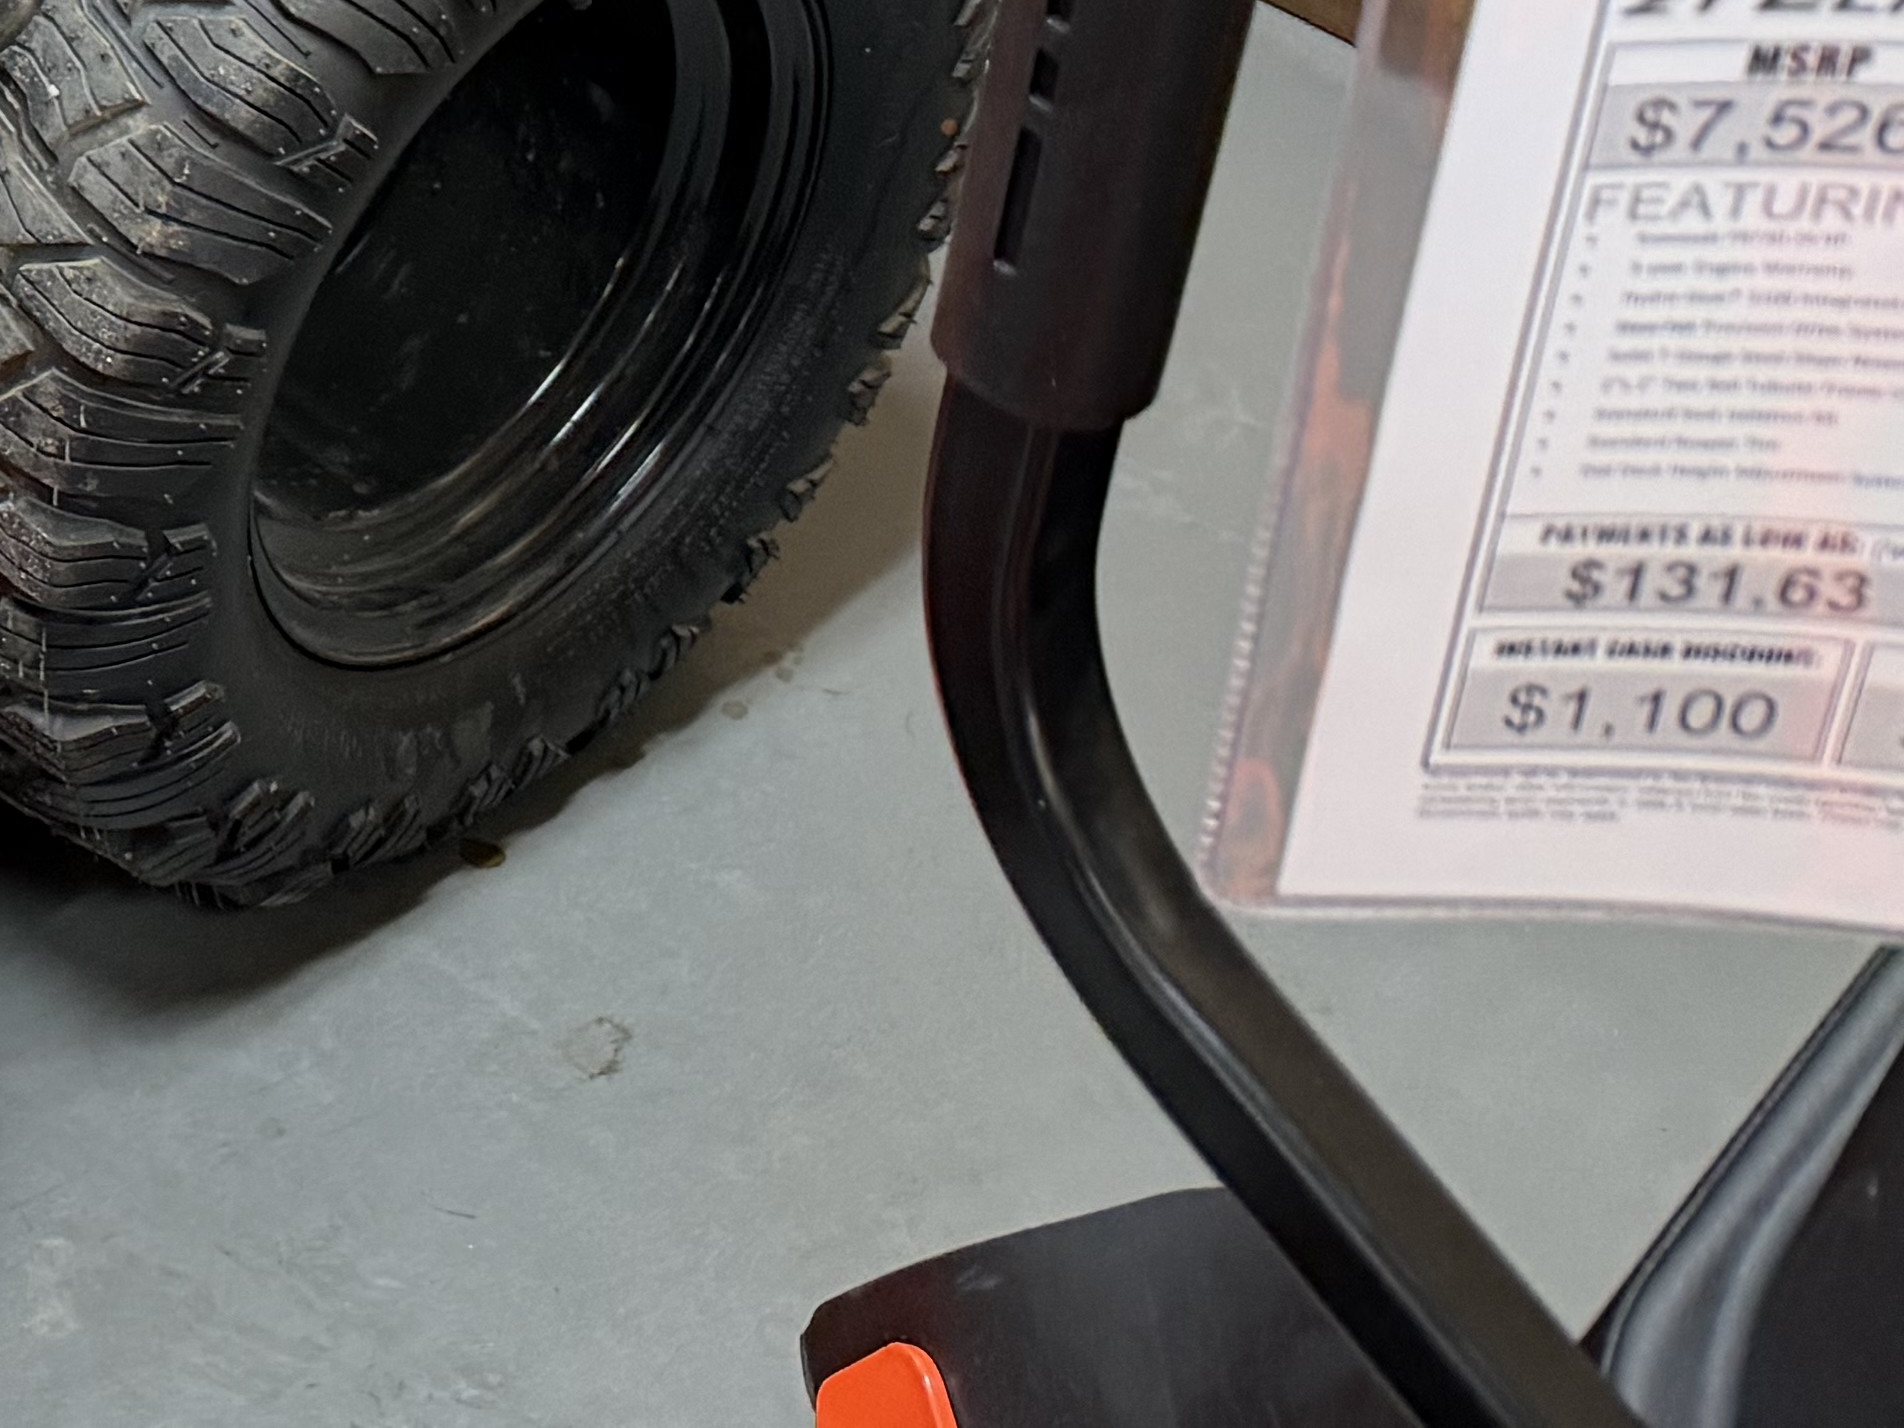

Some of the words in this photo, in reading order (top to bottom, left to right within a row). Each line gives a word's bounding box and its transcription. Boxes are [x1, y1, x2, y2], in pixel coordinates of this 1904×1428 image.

[1745, 43, 1874, 78] MSRP
[1628, 95, 1904, 165] $7,526
[1562, 556, 1873, 614] $131.63
[1502, 680, 1780, 741] $1,100
